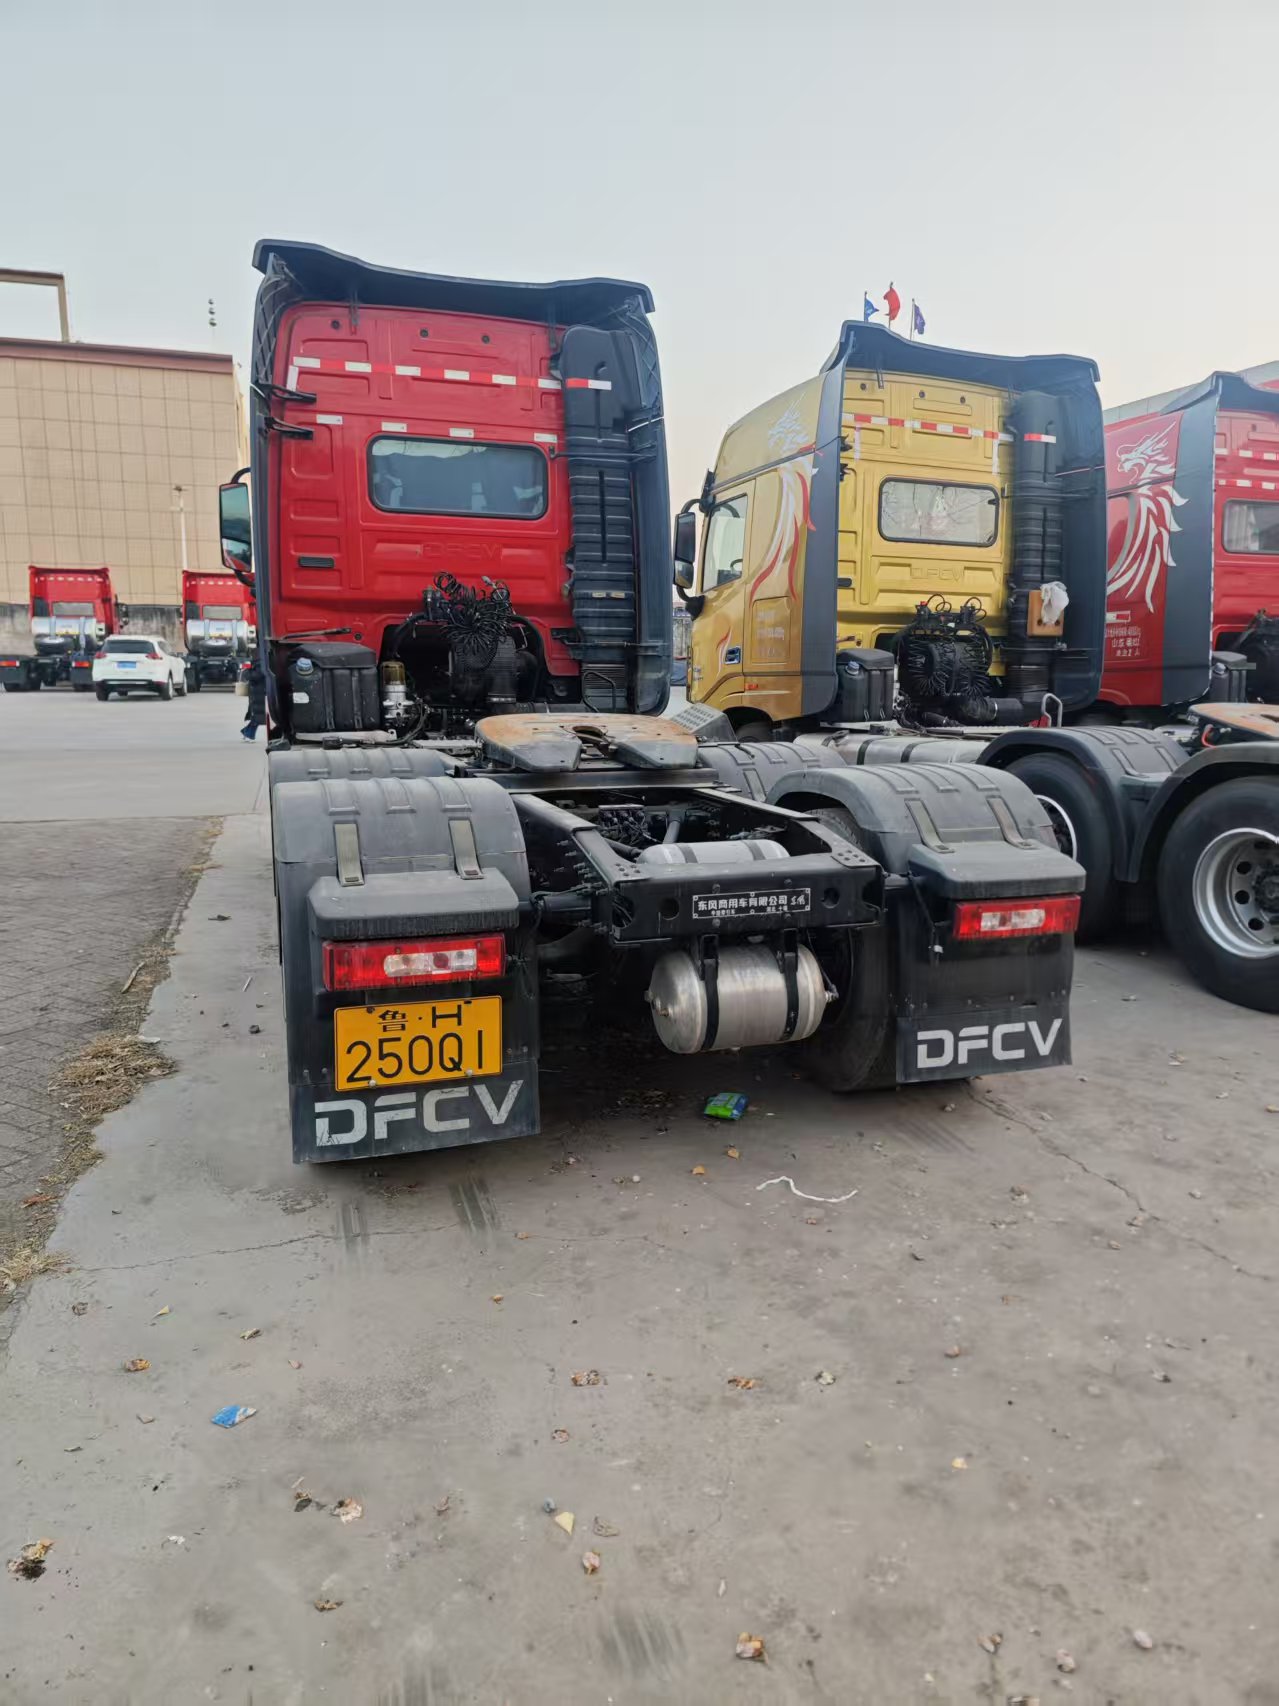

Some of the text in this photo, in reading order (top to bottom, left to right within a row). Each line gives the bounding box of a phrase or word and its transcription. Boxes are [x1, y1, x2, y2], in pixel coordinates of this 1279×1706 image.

[697, 895, 788, 912] 东风商用车有限公司
[346, 1029, 484, 1084] 250Q1
[917, 1018, 1063, 1069] DFCV
[314, 1080, 525, 1147] DFCV
